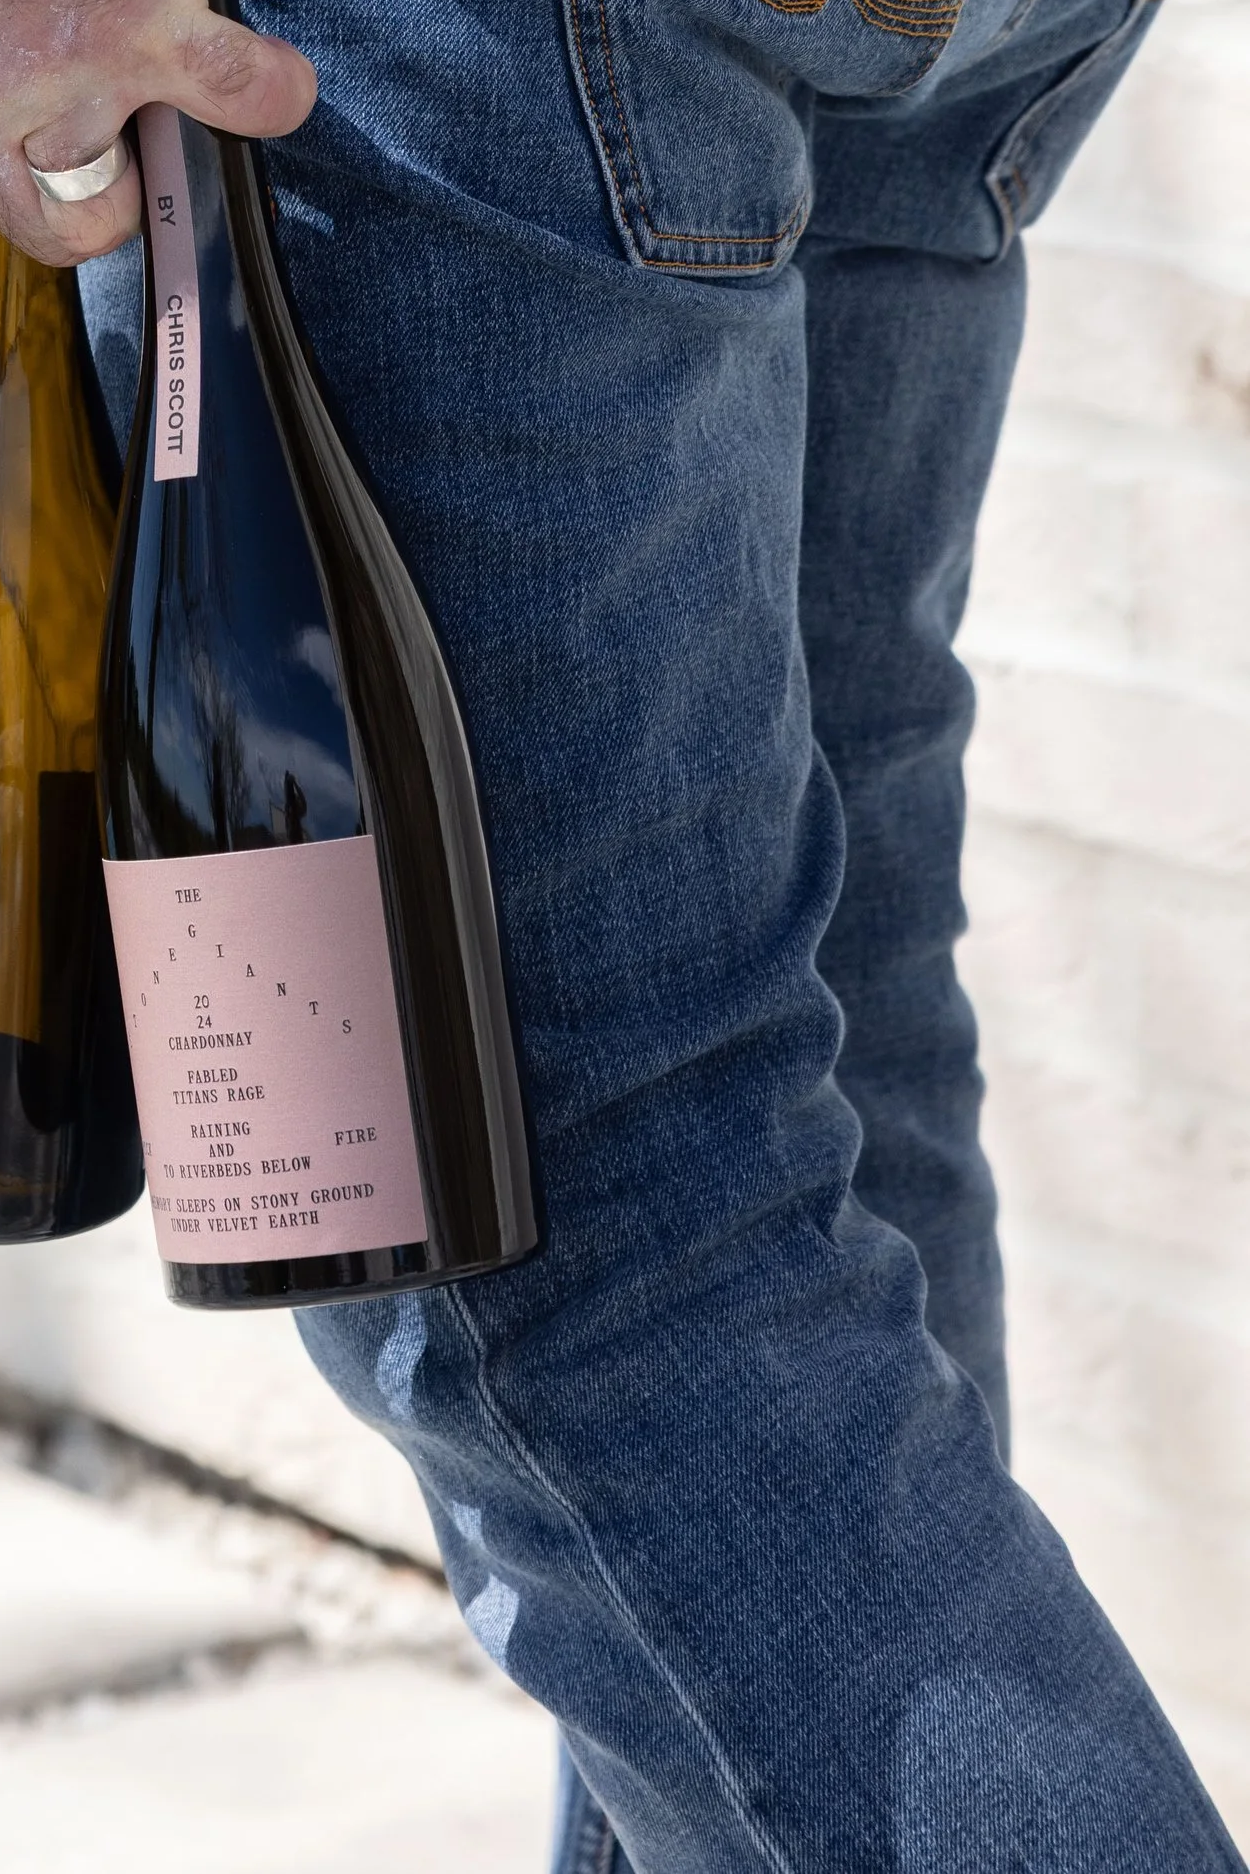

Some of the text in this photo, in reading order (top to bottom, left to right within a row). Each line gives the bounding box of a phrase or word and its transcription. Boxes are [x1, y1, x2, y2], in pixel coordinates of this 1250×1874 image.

[157, 195, 184, 454] BY CHRIS SCOTT
[175, 888, 202, 904] THE
[193, 994, 210, 1009] 20
[196, 1014, 212, 1029] 24
[168, 1031, 253, 1051] CHARDONNAY
[187, 1067, 238, 1085] FABLED
[172, 1085, 265, 1105] TITANS RAGE
[190, 1121, 251, 1139] RAINING
[209, 1126, 378, 1158] AND FIRE
[163, 1155, 312, 1179] TO RIVERBEDS BELOW
[176, 1197, 216, 1213] SLEEPS
[224, 1196, 241, 1212] ON
[250, 1191, 299, 1210] STONY
[310, 1183, 375, 1205] GROUND
[171, 1210, 320, 1233] UNDER VELVET EARTH
